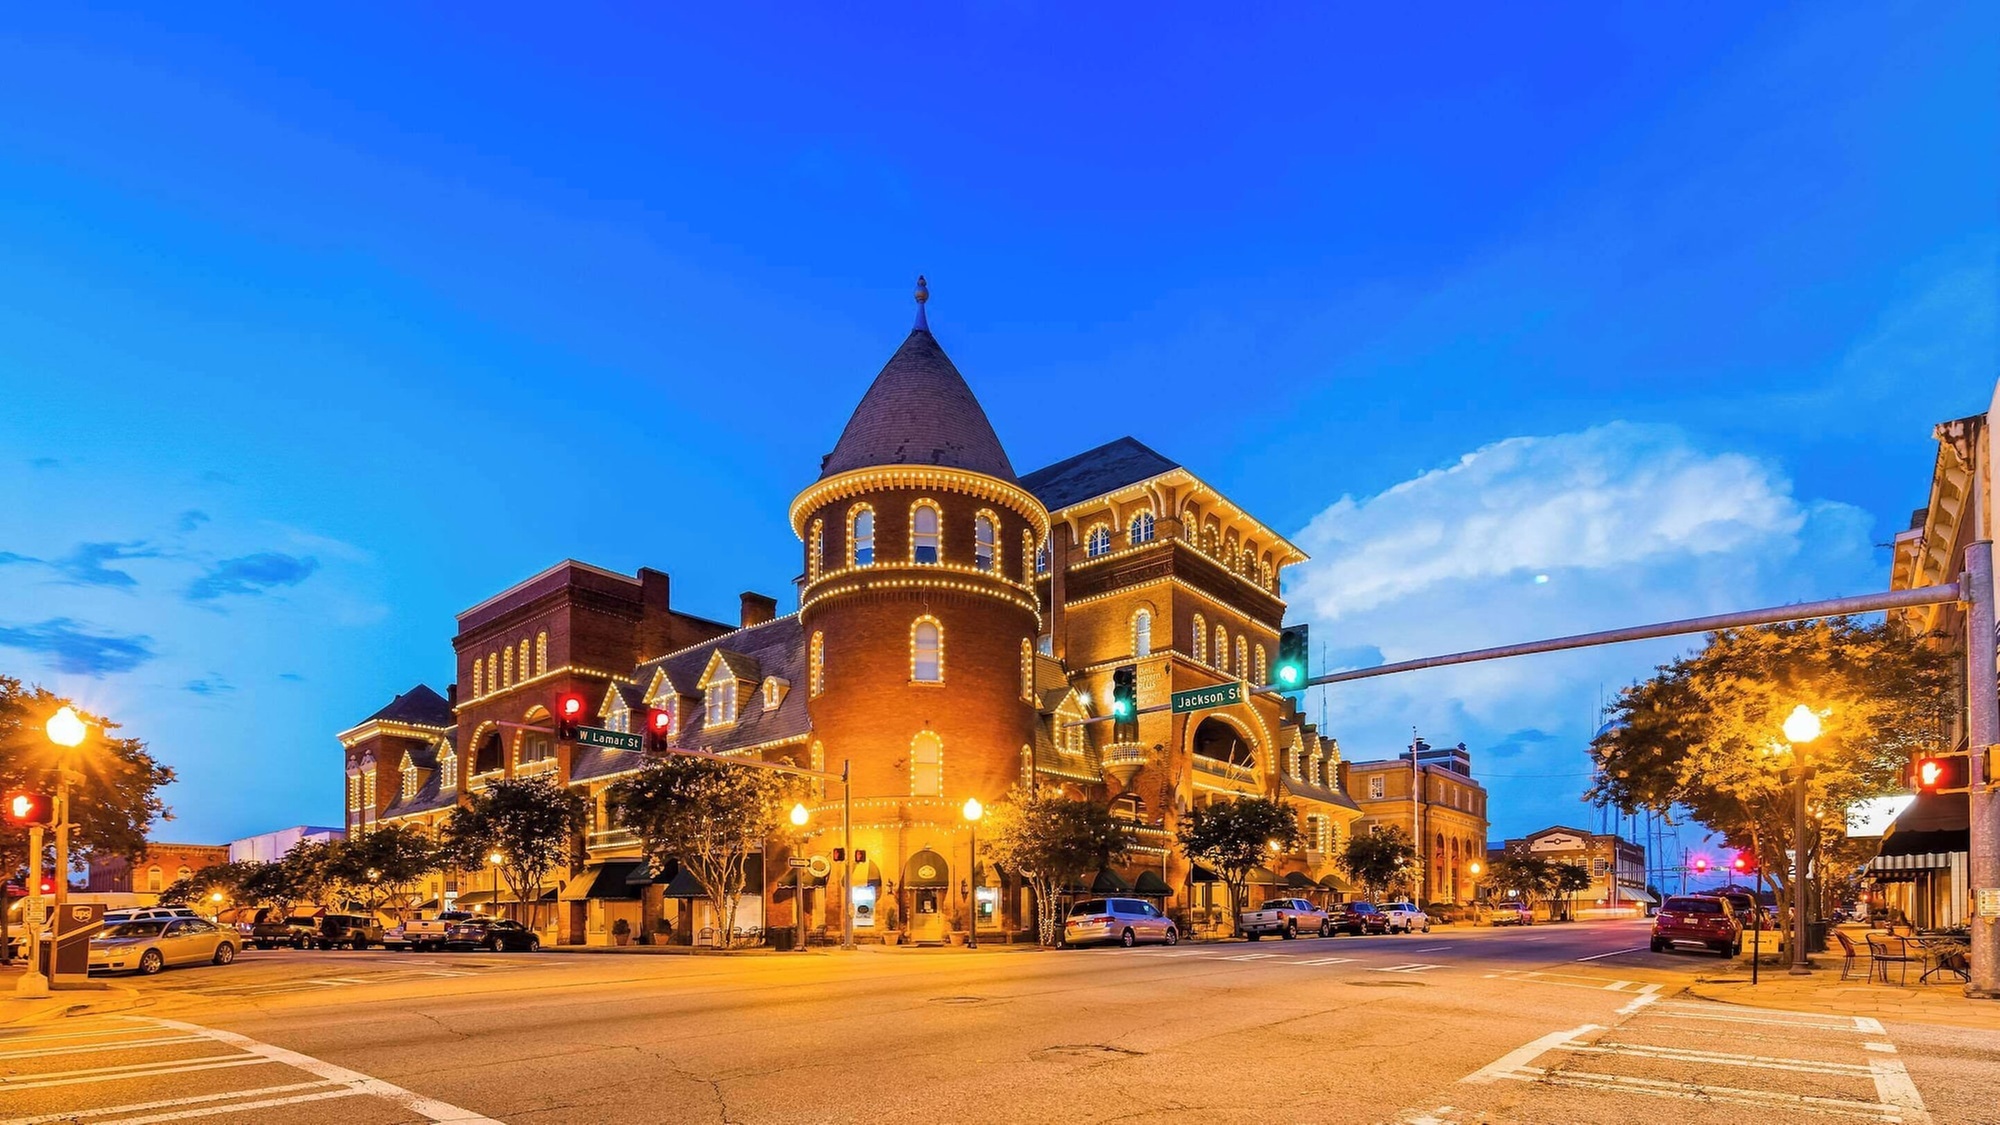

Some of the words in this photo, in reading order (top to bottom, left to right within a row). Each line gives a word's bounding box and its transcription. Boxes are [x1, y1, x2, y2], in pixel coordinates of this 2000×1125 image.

[1138, 673, 1162, 682] estern
[1178, 692, 1223, 708] Jackson
[1228, 687, 1241, 699] St
[579, 730, 588, 740] W
[592, 732, 624, 745] Lamar
[627, 737, 639, 748] St
